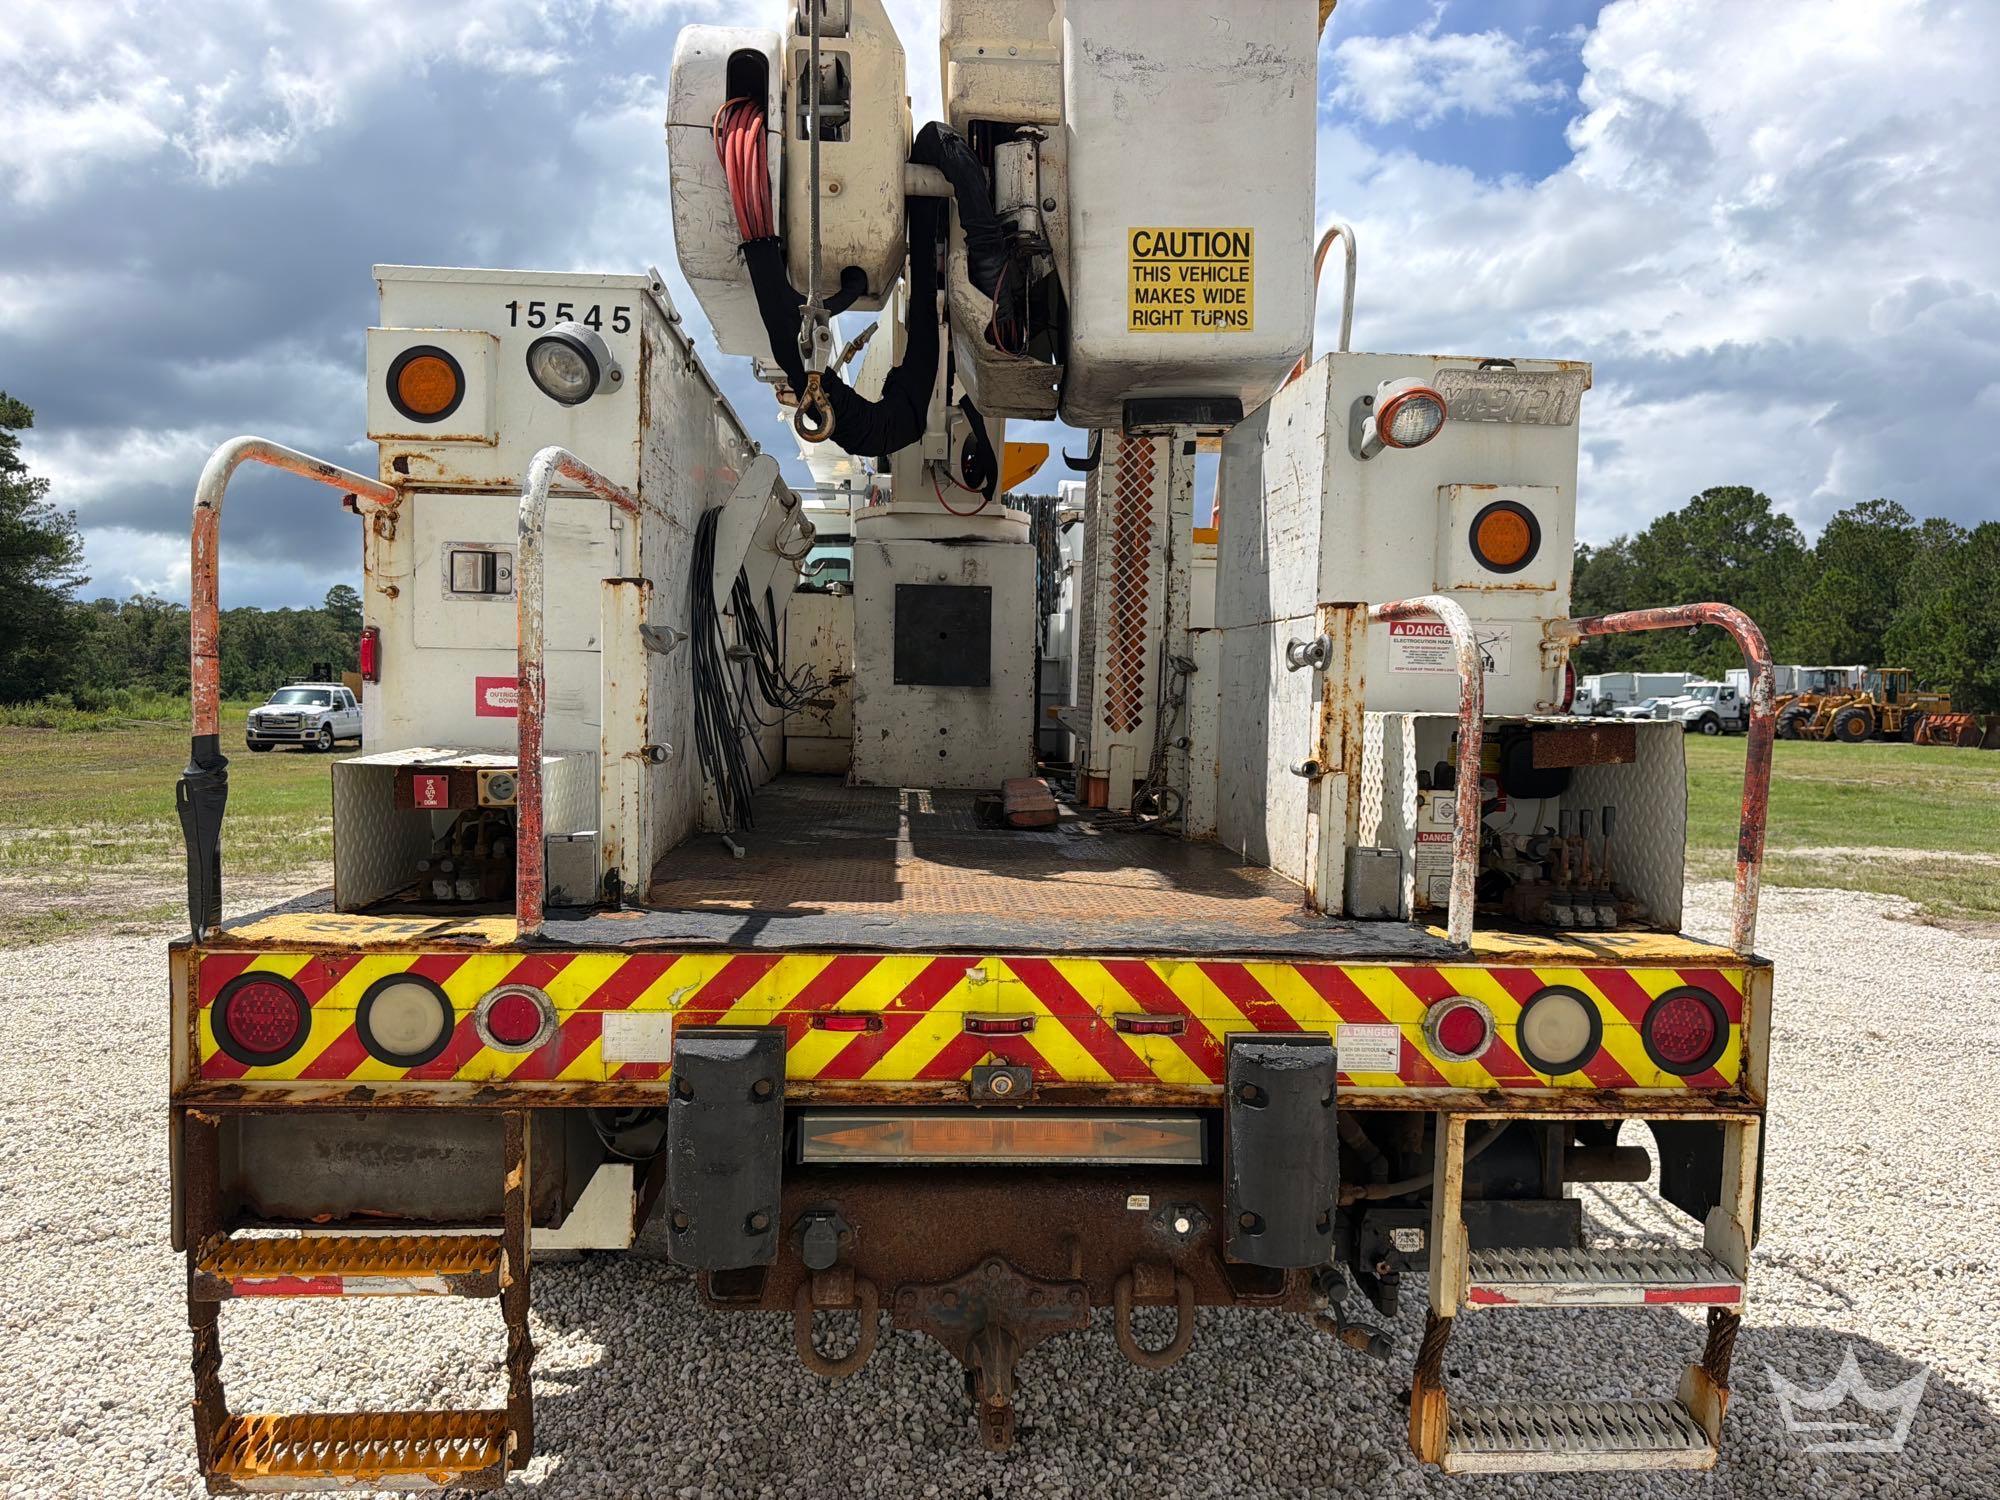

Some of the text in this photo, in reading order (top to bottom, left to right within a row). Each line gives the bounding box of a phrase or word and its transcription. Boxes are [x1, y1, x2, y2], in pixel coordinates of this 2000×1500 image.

[1132, 231, 1250, 257] CAUTION
[1133, 266, 1249, 282] THIS VEHICLE
[1135, 288, 1246, 304] MAKES WIDE
[505, 300, 631, 334] 15545
[1133, 310, 1248, 326] RIGHT TURNS
[1405, 624, 1452, 637] DANGE
[1422, 833, 1453, 842] DANGE
[1353, 1027, 1395, 1037] DANGER
